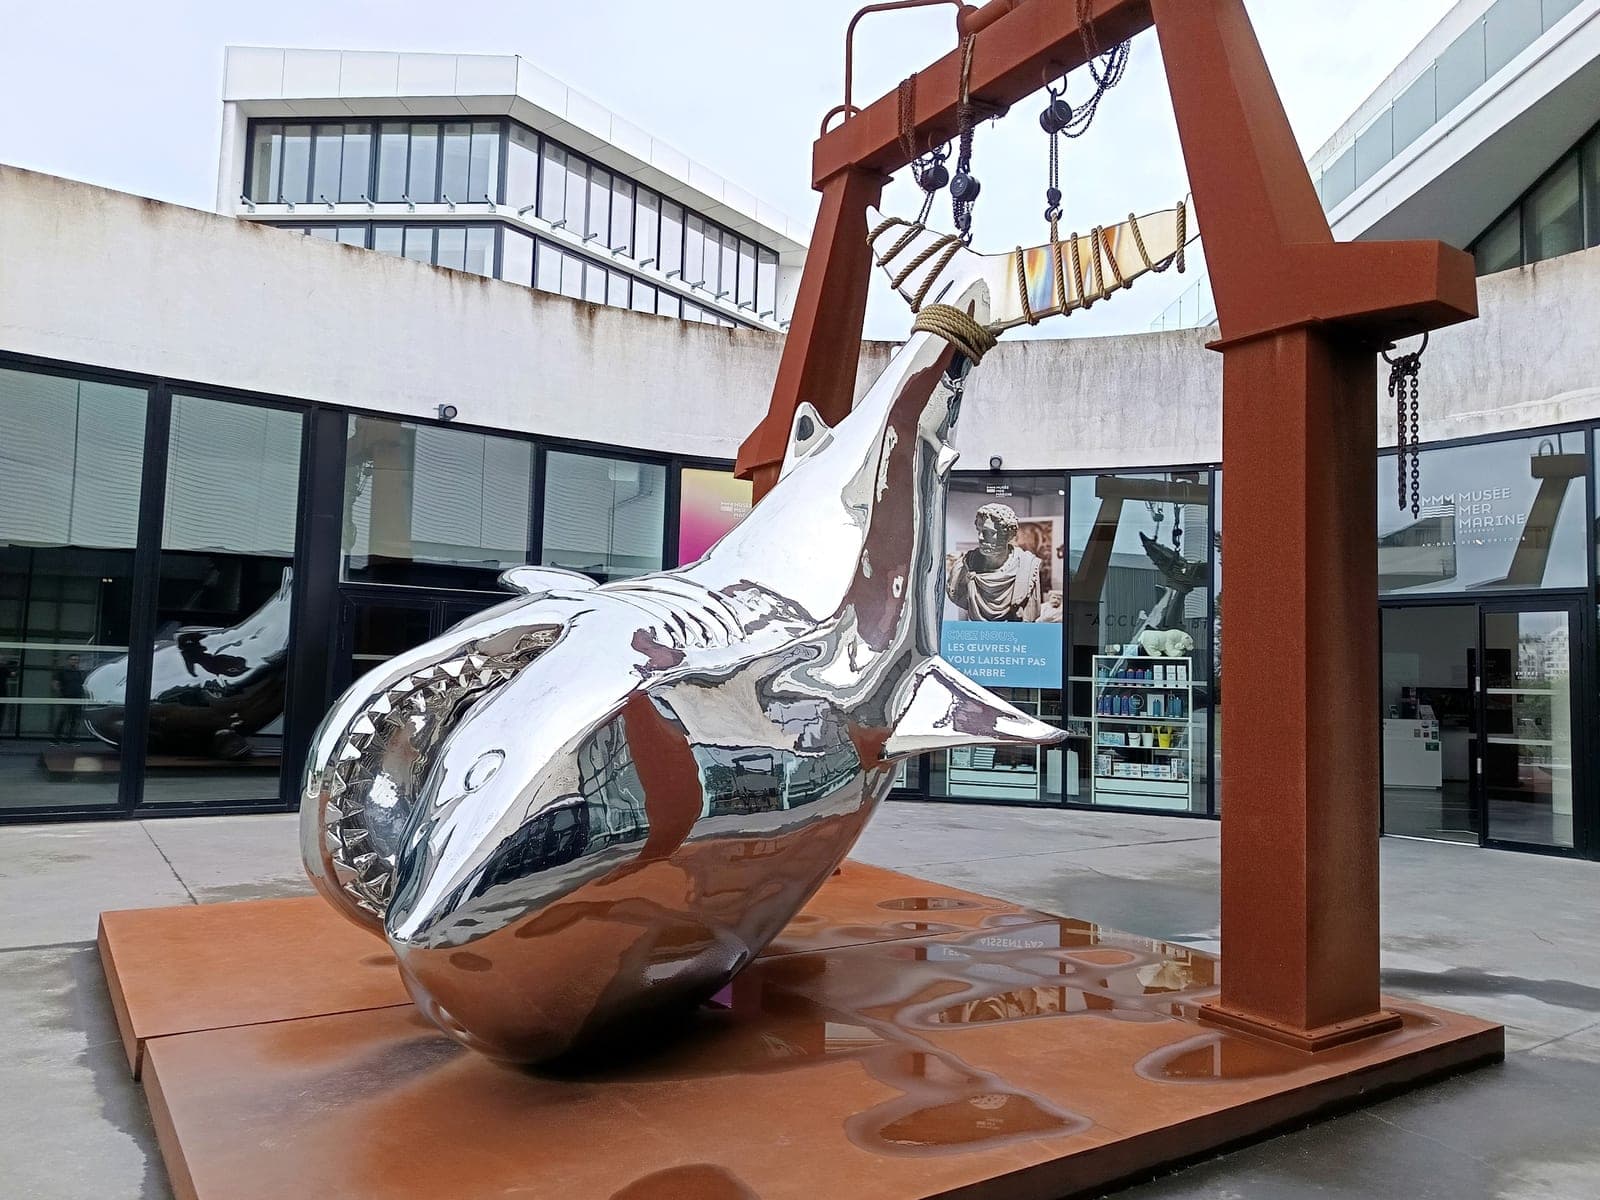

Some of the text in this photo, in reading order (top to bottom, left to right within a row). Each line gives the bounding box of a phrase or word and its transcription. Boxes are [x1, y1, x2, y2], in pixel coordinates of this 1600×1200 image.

[1459, 503, 1492, 515] MER
[1459, 513, 1526, 529] MARINE
[947, 643, 1027, 653] LES ŒUVRES NE
[947, 655, 1046, 666] VOUS LAISSENT PAS
[964, 668, 1006, 677] MARBRE
